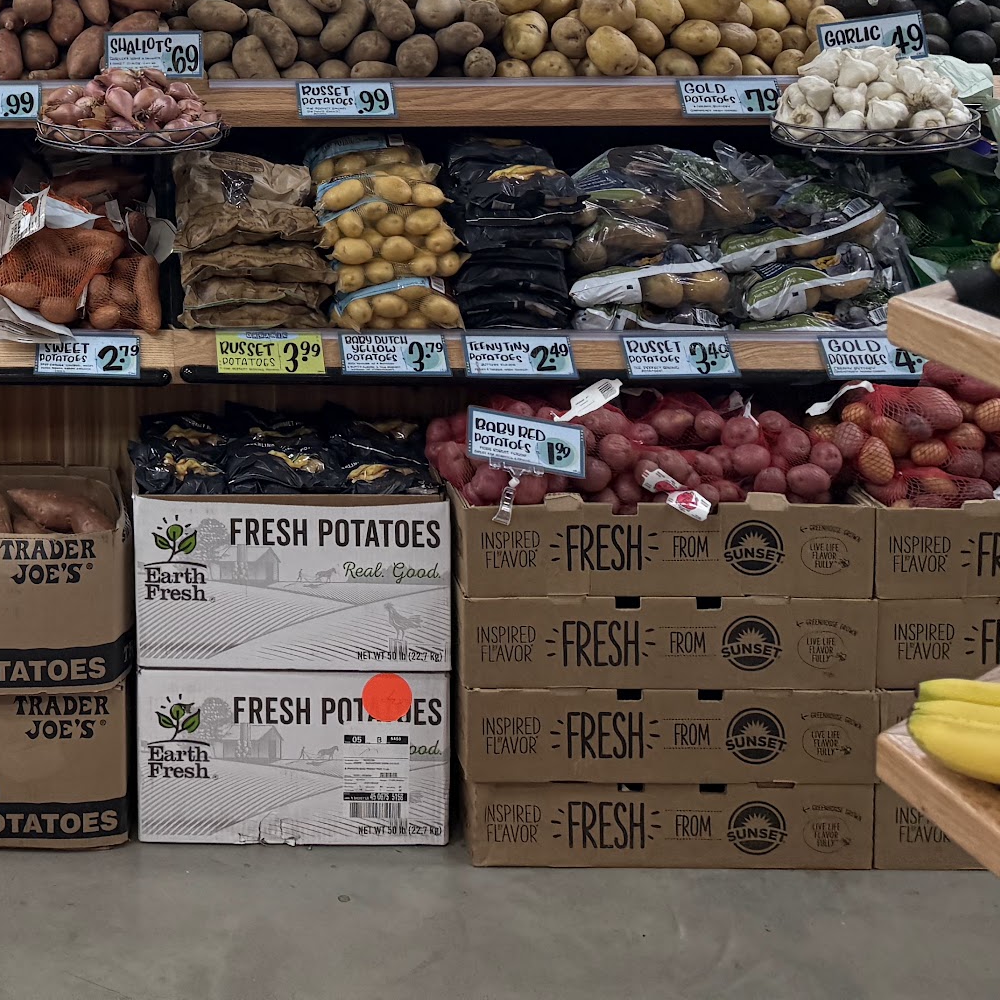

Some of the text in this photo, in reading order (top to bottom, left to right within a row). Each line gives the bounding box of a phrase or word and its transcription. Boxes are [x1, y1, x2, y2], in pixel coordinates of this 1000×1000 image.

[824, 26, 880, 46] GARLIC
[111, 37, 172, 55] SHALLOTS
[167, 44, 198, 73] .69
[302, 86, 350, 96] RUSSET
[684, 83, 725, 94] GOLD
[4, 92, 34, 116] .99
[302, 98, 354, 106] POTATOES
[358, 88, 389, 114] .99
[684, 95, 735, 103] POTATOES
[744, 88, 778, 112] .79
[45, 343, 90, 354] SWEET
[220, 341, 274, 356] RUSSET
[344, 336, 408, 344] BABY DUTCH
[352, 345, 396, 353] YELLOW
[469, 342, 530, 353] TEENY TINY
[626, 340, 681, 354] RUSSET
[828, 340, 880, 352] GOLD
[40, 354, 87, 362] POTATOES
[98, 345, 139, 372] 2.79
[222, 358, 275, 366] POTATOES
[284, 341, 320, 372] 3.99
[346, 354, 397, 362] POTATOES
[408, 341, 443, 372] 3.79
[470, 353, 522, 362] POTATOES
[530, 343, 568, 371] 2.49
[629, 355, 680, 363] POTATOES
[828, 354, 887, 365] POTATOES
[475, 418, 546, 442] BABY RED
[474, 432, 531, 454] POTATOES
[230, 517, 441, 548] FRESH POTATOES
[481, 531, 540, 549] INSPIRED
[0, 539, 96, 560] TRADER
[567, 525, 709, 572] FRESH FROM
[810, 543, 839, 551] LIVE LIFE
[889, 536, 951, 554] INSPIRED
[485, 549, 537, 568] FLAVOR
[724, 547, 785, 563] SUNSET
[812, 552, 837, 560] FLAVOR
[894, 555, 947, 572] FLAVOR
[10, 563, 83, 585] JOE'S
[144, 566, 207, 585] Earth
[343, 561, 442, 584] Real. Good.
[144, 584, 208, 601] Fresh
[477, 626, 536, 645] INSPIRED
[894, 624, 954, 640] INSPIRED
[562, 621, 706, 667] FRESH FROM
[721, 643, 782, 658] SUNSET
[898, 643, 950, 660] FLAVOR
[481, 644, 532, 663] FLAVOR
[13, 695, 110, 716] TRADER
[233, 697, 442, 726] FRESH POTES
[25, 719, 97, 740] JOE'S
[482, 717, 541, 736] INSPIRED
[567, 712, 710, 759] FRESH FROM
[409, 740, 442, 755] ood.
[486, 736, 538, 755] FLAVOR
[725, 736, 787, 751] SUNSET
[147, 745, 210, 762] Earth
[147, 762, 210, 779] Fresh
[484, 804, 542, 824] INSPIRED
[486, 823, 538, 843] FLAVOR
[567, 801, 712, 849] FRESH FROM
[727, 828, 788, 843] SUNSET
